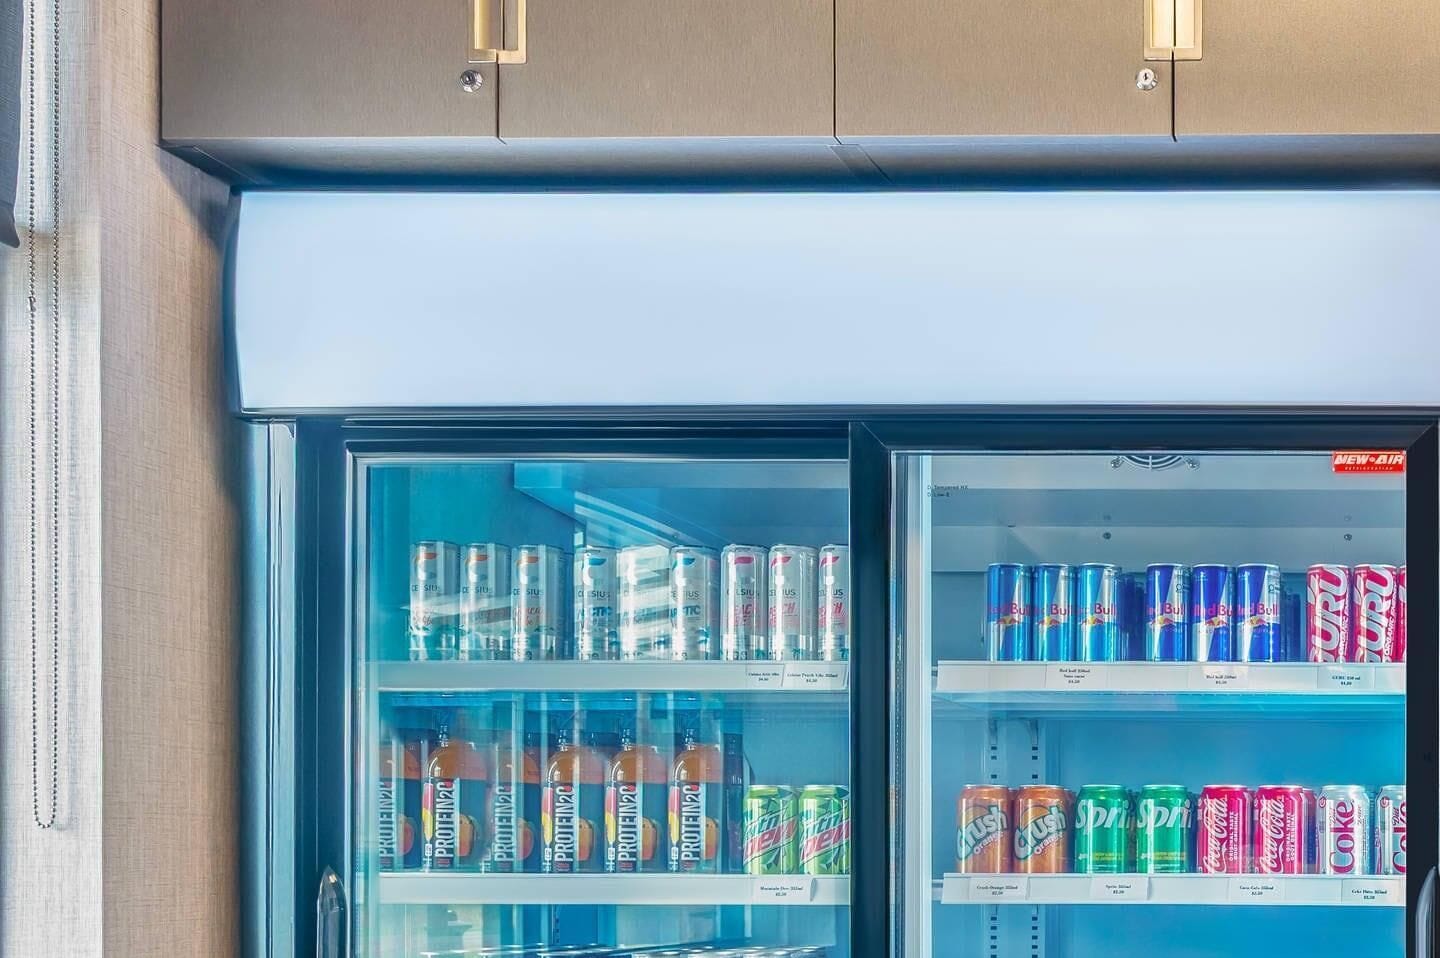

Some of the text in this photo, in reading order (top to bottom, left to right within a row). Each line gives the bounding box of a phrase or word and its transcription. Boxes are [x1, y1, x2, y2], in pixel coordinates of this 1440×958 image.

[1334, 454, 1404, 465] NEW AIR
[411, 584, 441, 592] CESIU
[512, 588, 543, 596] CESIU
[1257, 602, 1278, 615] Bull
[956, 805, 1009, 860] Crush
[1014, 806, 1066, 860] Crush
[1075, 800, 1131, 835] Spri
[1137, 800, 1192, 835] Spri
[1203, 794, 1229, 873] Coca-Cola
[1260, 794, 1286, 873] Coca-Cola
[1329, 801, 1355, 874] Coke
